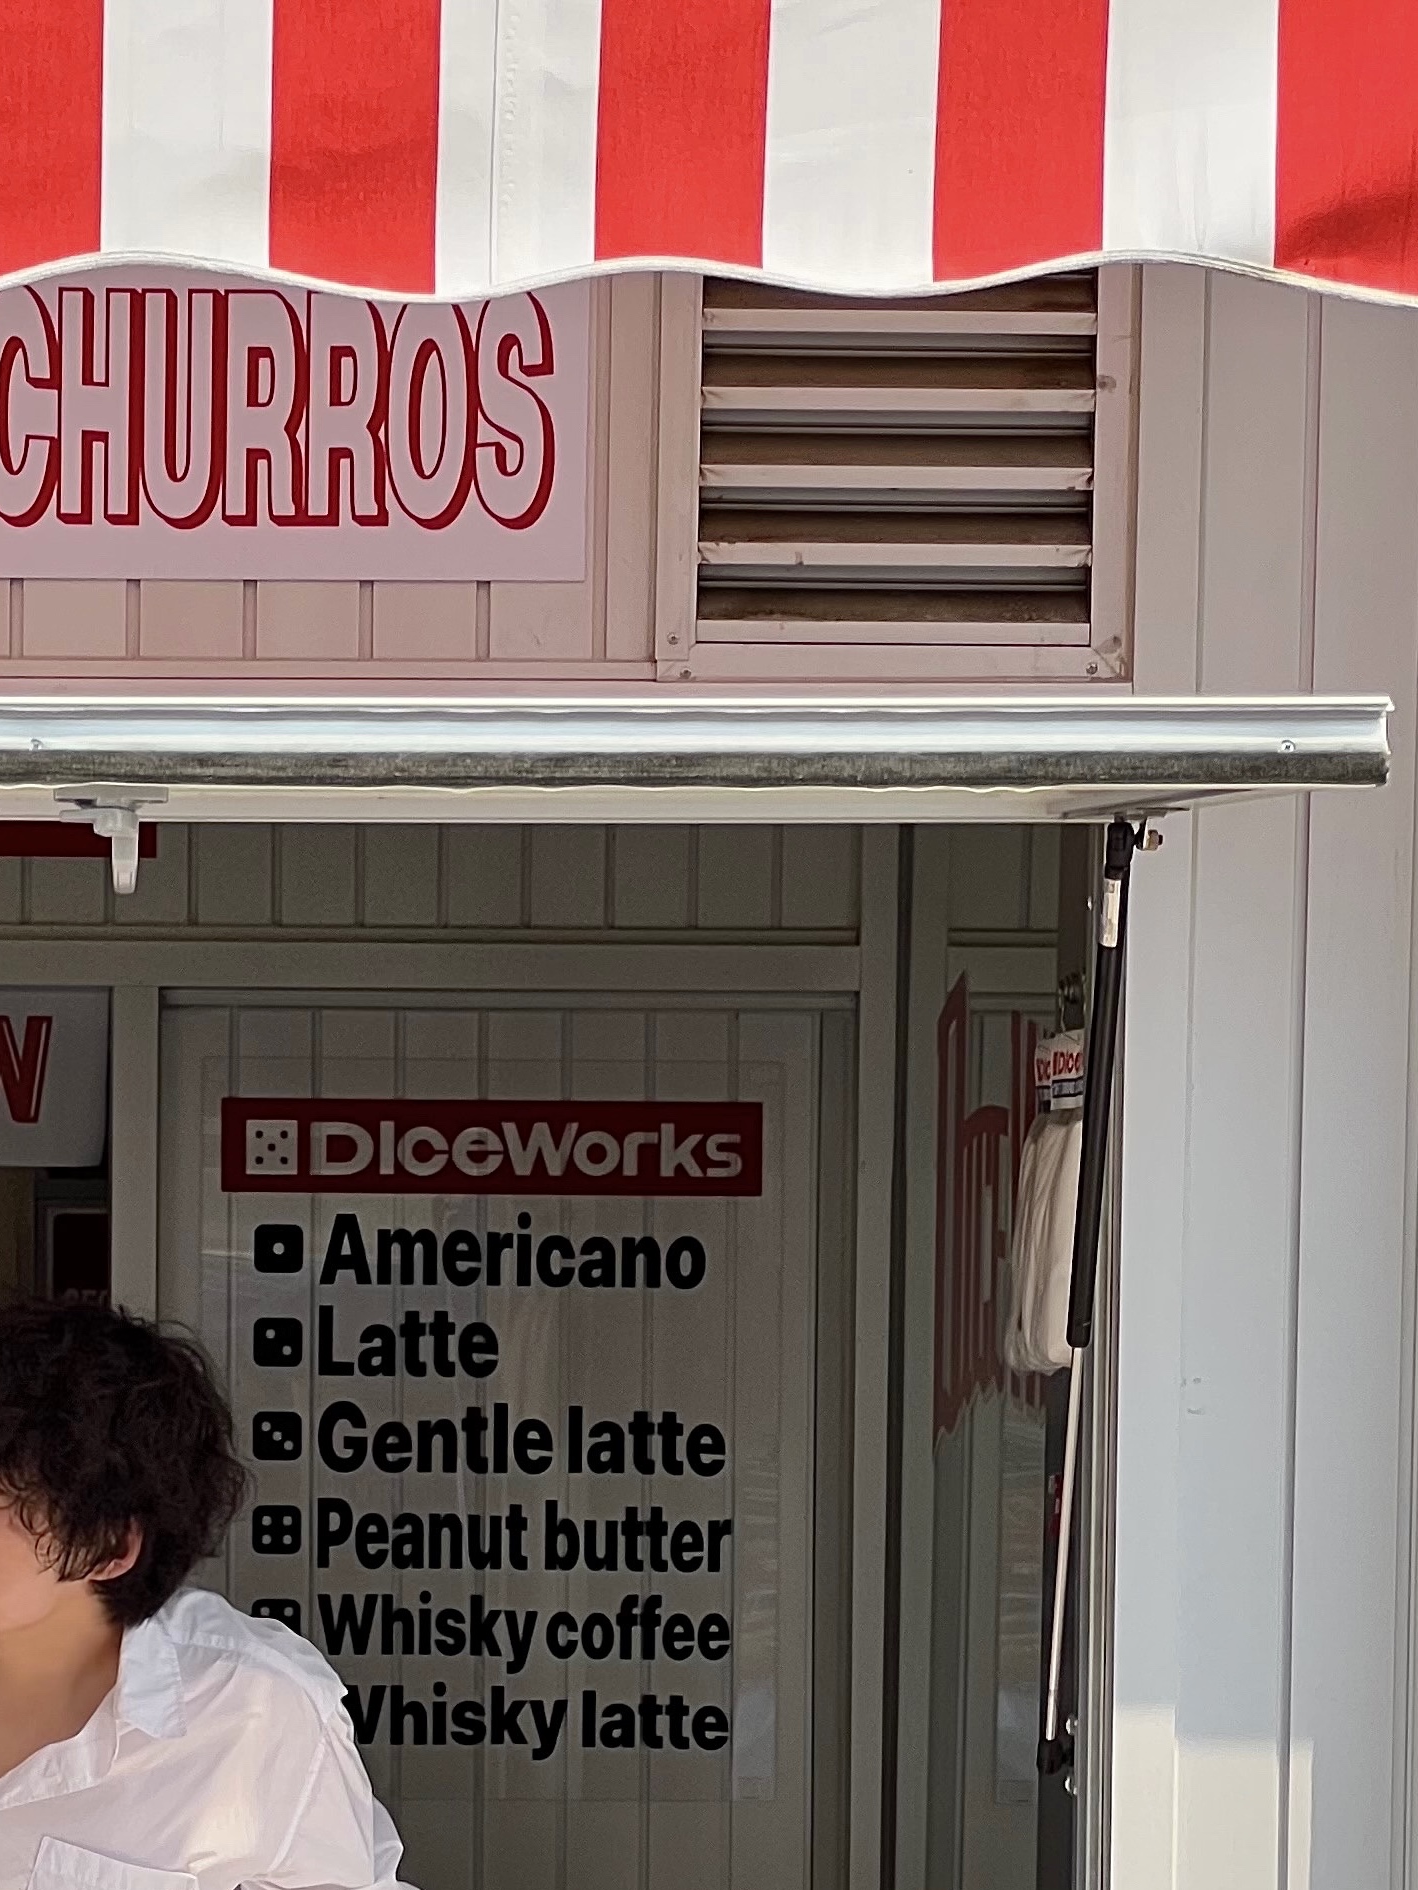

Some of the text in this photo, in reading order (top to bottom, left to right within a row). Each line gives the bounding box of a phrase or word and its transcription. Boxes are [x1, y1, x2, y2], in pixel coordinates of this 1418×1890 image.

[319, 1211, 706, 1290] Americano
[318, 1304, 499, 1378] Latte
[318, 1400, 726, 1477] Gentle latte
[317, 1497, 732, 1573] Peanut butter
[318, 1591, 731, 1675] Whisky coffee
[581, 1690, 729, 1750] latte
